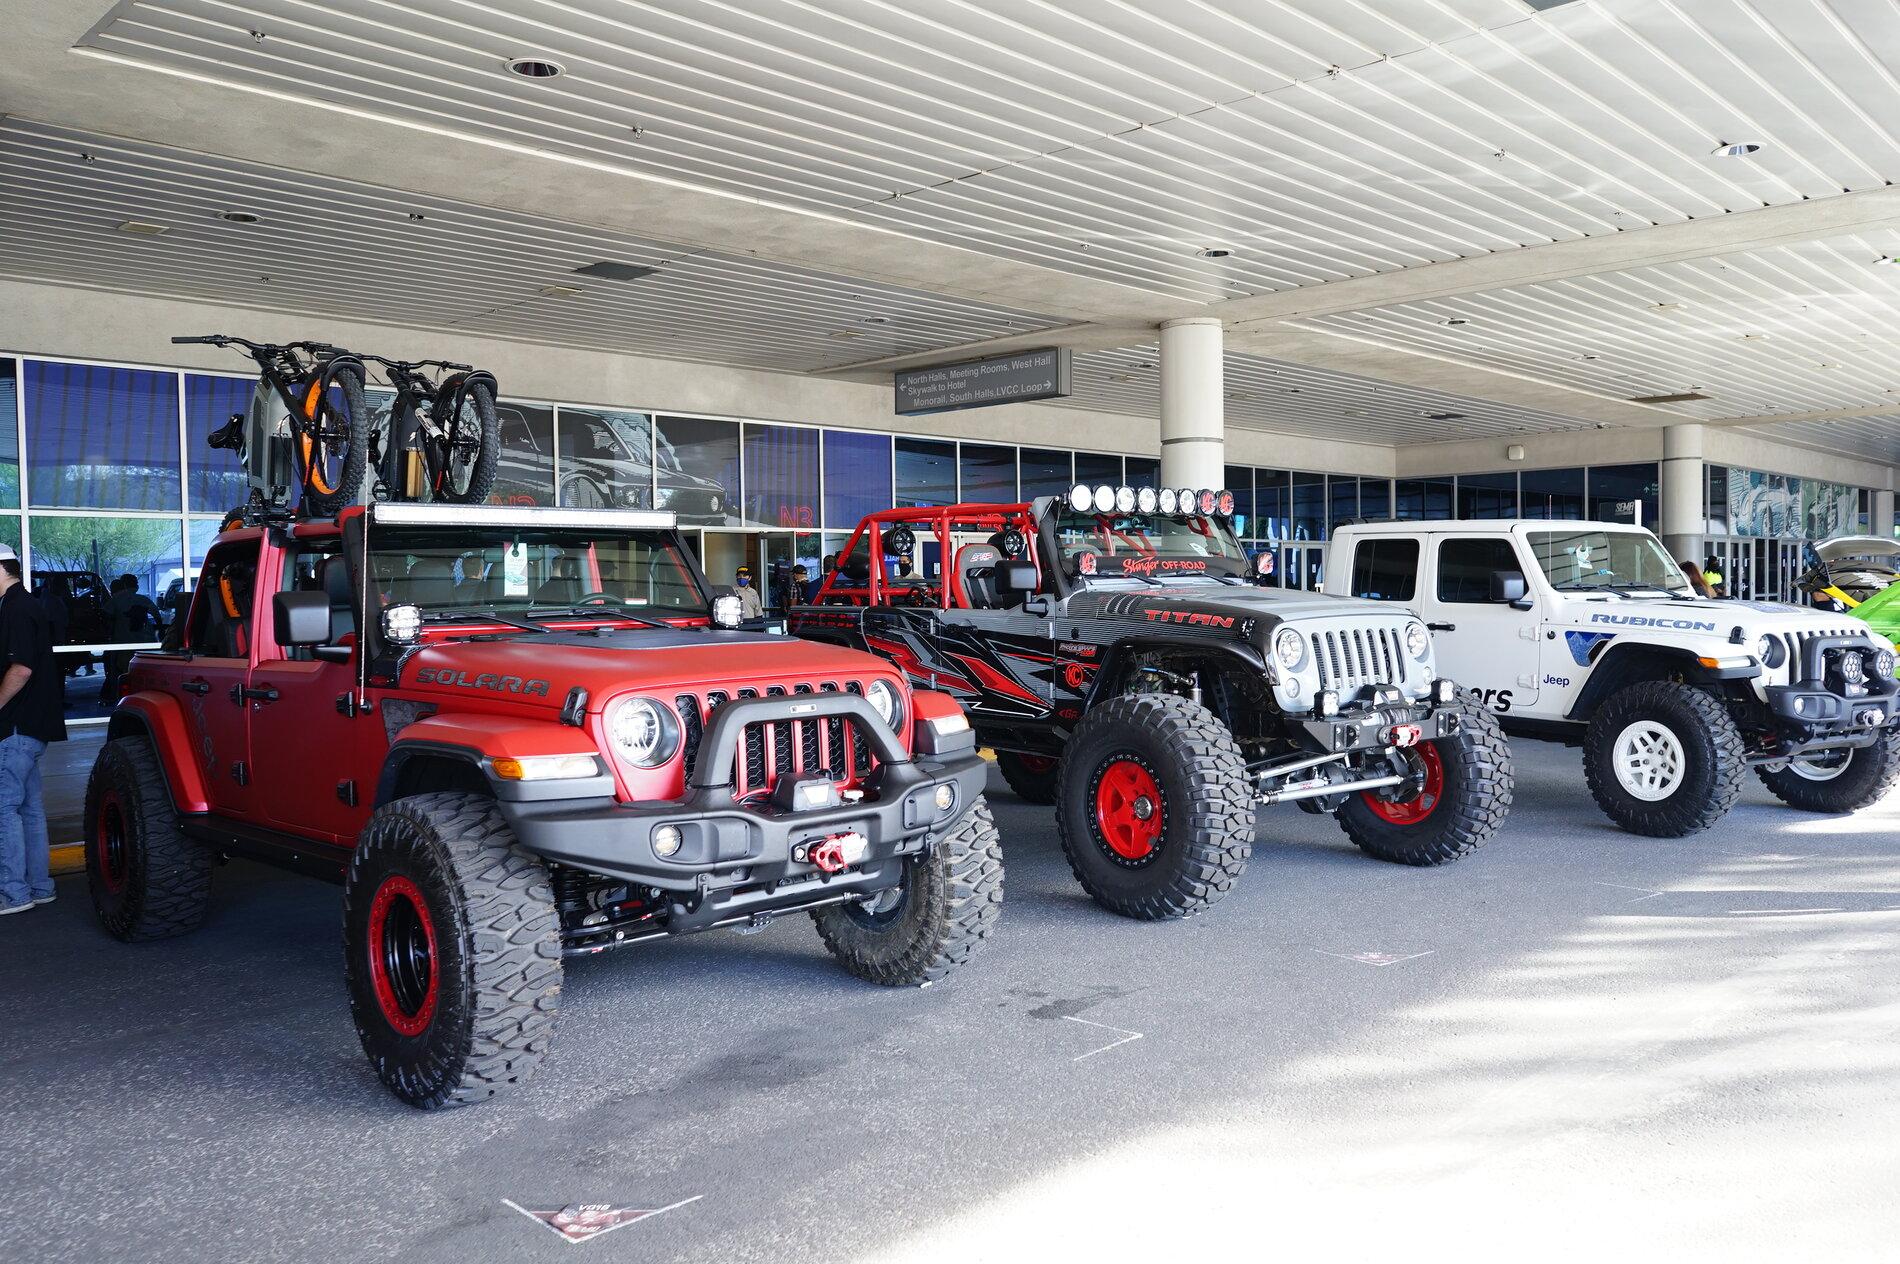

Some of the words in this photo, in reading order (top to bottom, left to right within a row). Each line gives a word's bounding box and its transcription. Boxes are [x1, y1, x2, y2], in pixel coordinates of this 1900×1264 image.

[907, 375, 928, 385] North
[928, 372, 948, 382] Halls,
[950, 367, 979, 379] Meeting
[980, 363, 1010, 374] Rooms,
[1011, 359, 1033, 371] West
[1034, 355, 1051, 367] Hall
[908, 384, 938, 396] Skywalk
[938, 383, 946, 392] to
[947, 380, 966, 391] Hotel
[950, 392, 972, 403] South
[1021, 383, 1043, 393] Loop
[1122, 556, 1160, 576] Stinger
[1161, 560, 1206, 570] OFF-ROAD
[1144, 609, 1235, 629] TITAN
[1591, 613, 1716, 631] RUBICON
[416, 667, 550, 697] SOLARA
[1067, 667, 1082, 683] KC
[1543, 674, 1570, 688] Jeep
